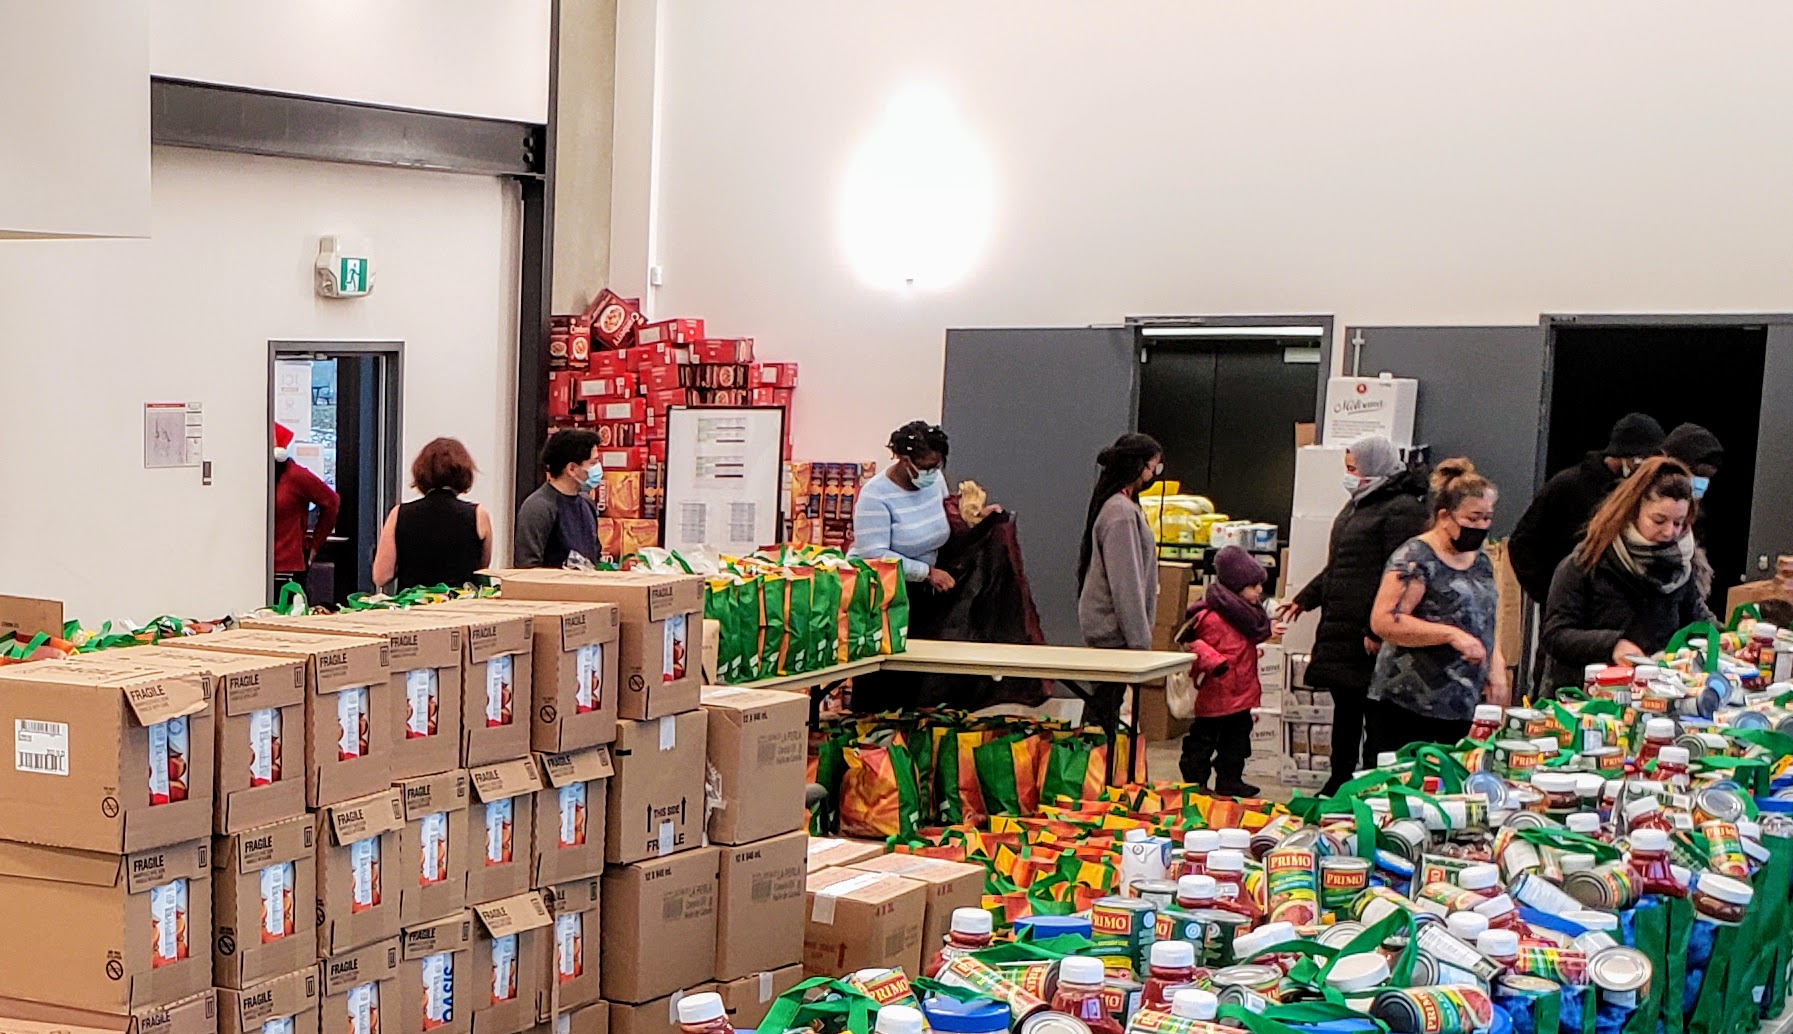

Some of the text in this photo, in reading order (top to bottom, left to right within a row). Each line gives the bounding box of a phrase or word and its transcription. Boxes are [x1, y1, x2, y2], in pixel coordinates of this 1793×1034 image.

[390, 635, 418, 647] FRAGILE
[320, 653, 347, 667] FRAGILE
[230, 674, 260, 690] FRAGILE
[130, 684, 165, 702] FRAGILE
[407, 785, 431, 798] FRAGILE
[337, 810, 364, 825] FRAGILE
[667, 804, 680, 815] SIDE
[244, 836, 272, 852] FRAGILE
[647, 833, 685, 852] FRLE
[134, 855, 164, 872] FRAGILE
[1270, 855, 1312, 869] PRIMO
[1326, 873, 1363, 885] PRIMO
[330, 958, 358, 975] FRAGILE
[243, 990, 272, 1010] FRAGILE
[141, 1011, 171, 1029] FRAGILE
